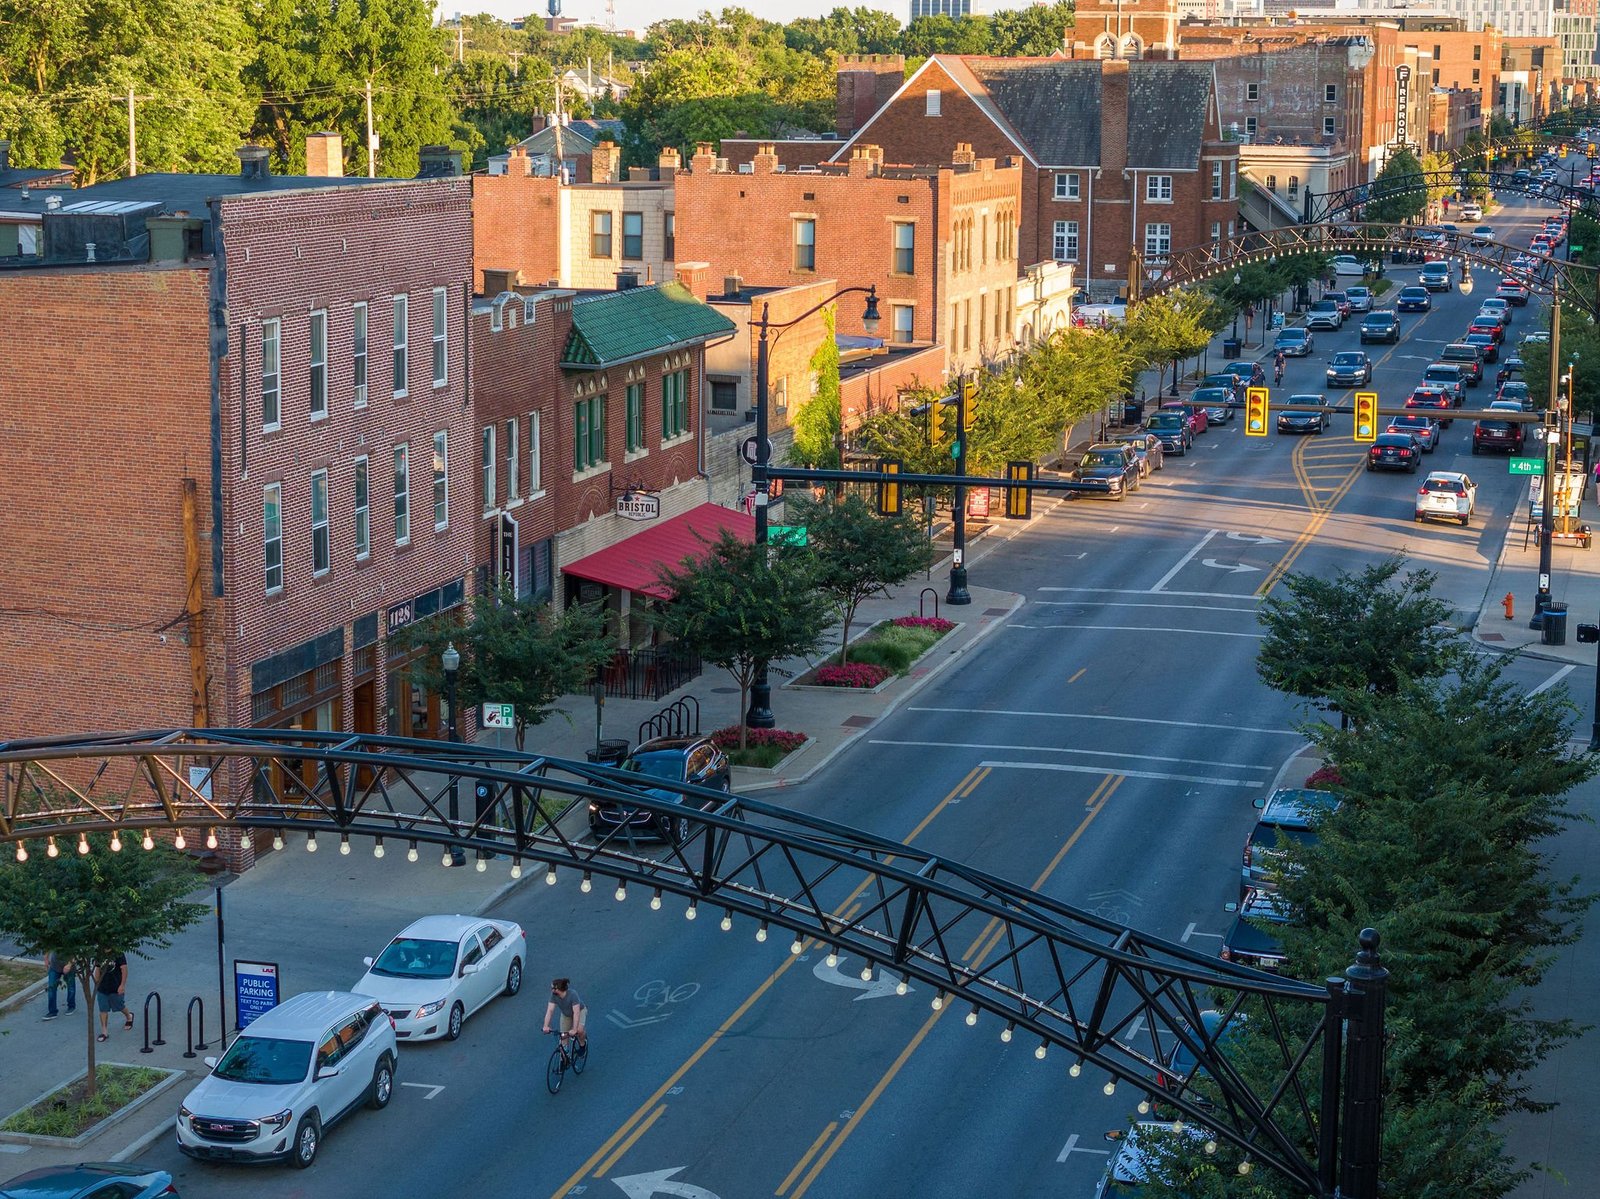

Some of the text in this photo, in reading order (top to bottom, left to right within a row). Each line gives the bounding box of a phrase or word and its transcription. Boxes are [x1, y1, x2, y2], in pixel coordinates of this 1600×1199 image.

[1398, 71, 1408, 142] FIREPROOF
[1518, 462, 1531, 471] 4th
[618, 502, 656, 513] BRISTOL
[504, 545, 512, 592] 112
[389, 605, 410, 628] 1128
[503, 706, 511, 716] P
[243, 978, 270, 989] PUBLIC
[240, 986, 274, 997] PARKING
[210, 1123, 234, 1132] GMC
